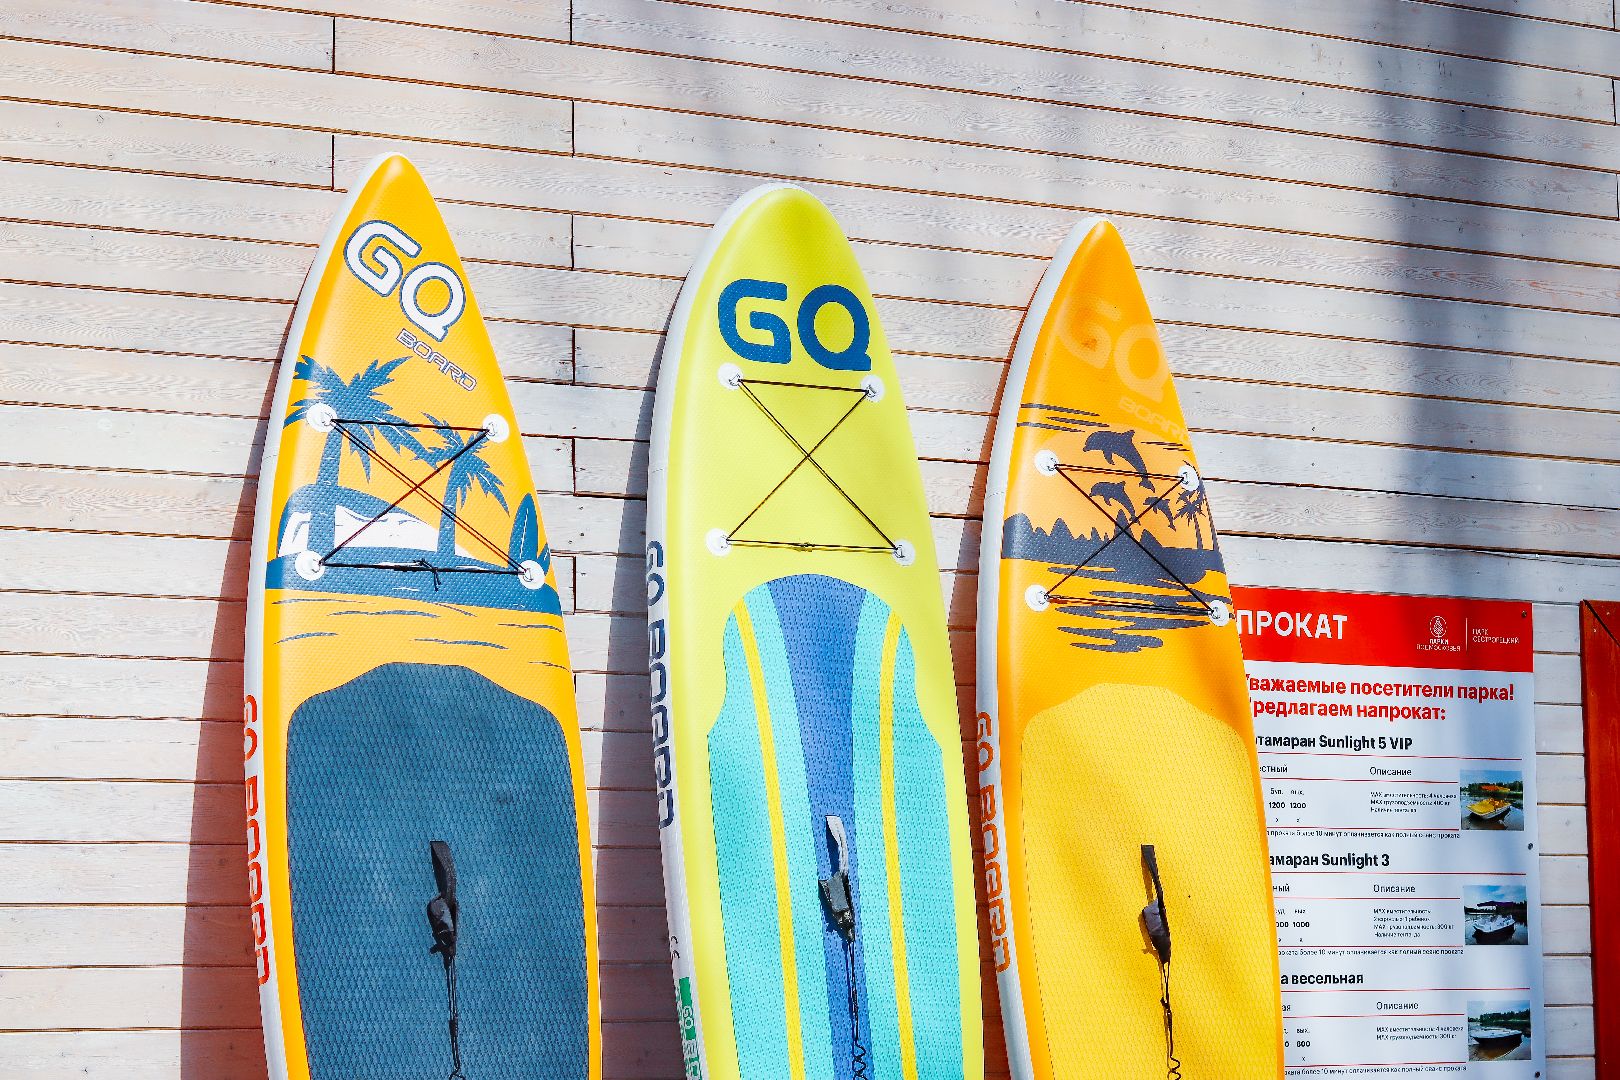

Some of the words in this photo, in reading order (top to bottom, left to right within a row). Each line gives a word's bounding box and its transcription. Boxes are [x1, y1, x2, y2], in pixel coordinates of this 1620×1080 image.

[396, 328, 477, 391] BOARD
[1236, 610, 1347, 640] ПРОКАТ
[1246, 674, 1346, 694] важаемые
[1351, 681, 1453, 698] посетители
[1457, 684, 1514, 703] парка!
[1249, 697, 1352, 719] редлагаем
[1356, 705, 1446, 722] напрокат:
[1255, 735, 1316, 749] тамаран
[1319, 735, 1376, 751] Sunlight
[1378, 736, 1387, 749] 5
[1389, 737, 1413, 750] VIP
[1259, 764, 1288, 773] стный
[1369, 767, 1412, 776] Описание
[1269, 855, 1319, 868] амаран
[1321, 853, 1379, 869] Sunlight
[1381, 854, 1390, 867] 3
[1373, 884, 1416, 893] Описание
[1291, 974, 1364, 985] весельная
[1376, 1001, 1419, 1010] Описание
